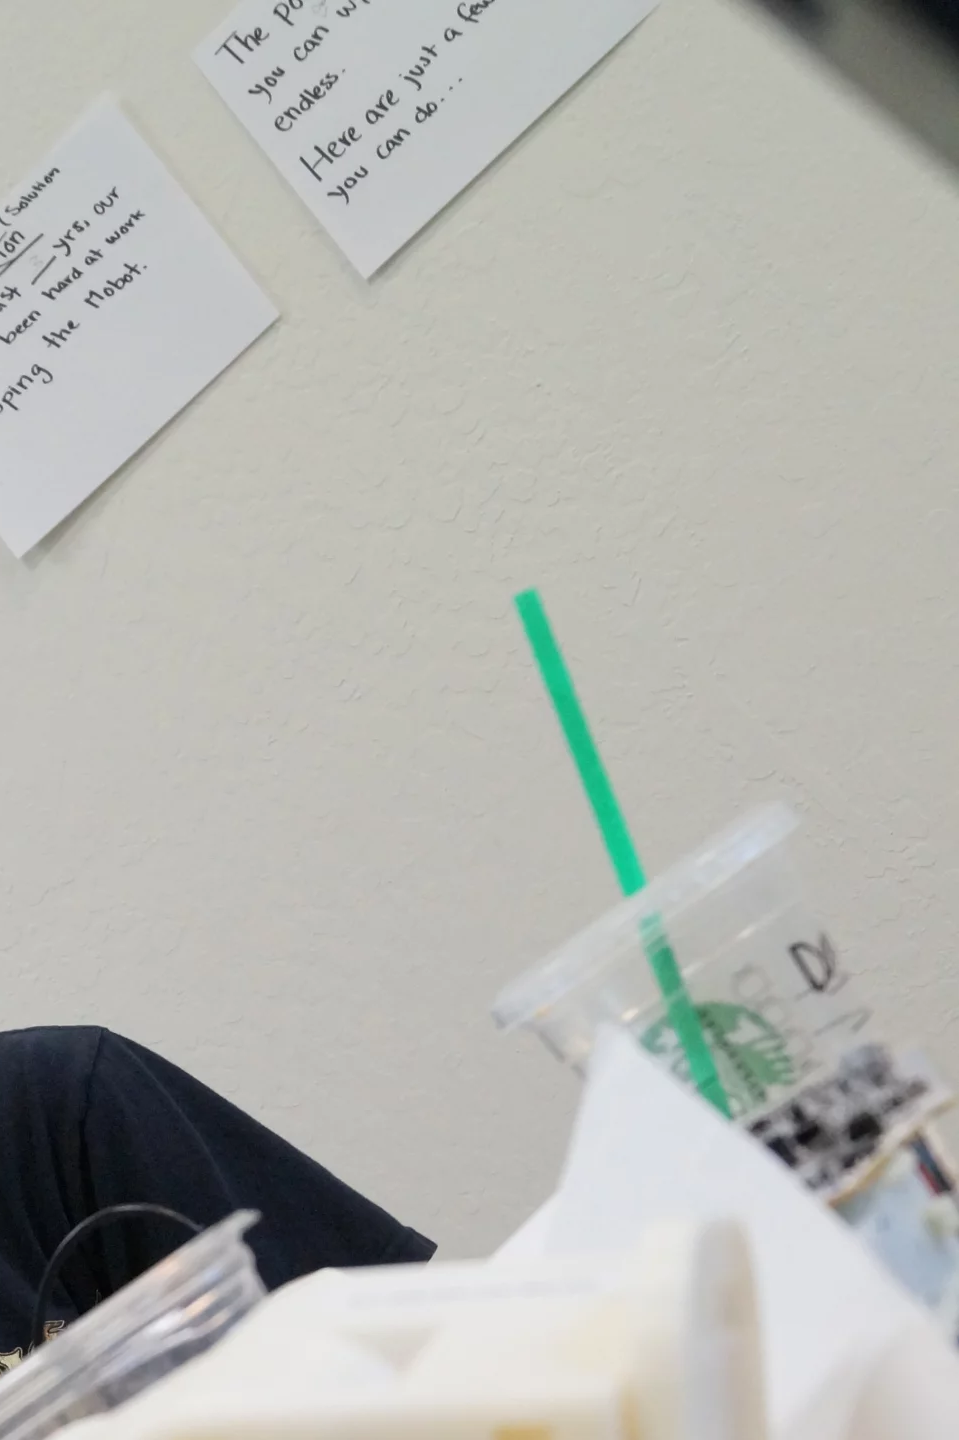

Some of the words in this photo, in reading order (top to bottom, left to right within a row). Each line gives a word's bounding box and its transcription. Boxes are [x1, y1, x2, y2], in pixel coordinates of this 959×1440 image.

[214, 26, 270, 64] The
[248, 65, 286, 104] you
[293, 25, 330, 62] can
[274, 68, 347, 132] endless.
[299, 125, 363, 182] Here
[365, 88, 400, 125] are
[399, 44, 438, 91] just
[444, 27, 463, 42] a
[93, 184, 122, 217] our
[327, 164, 369, 205] you
[376, 127, 411, 160] can
[41, 266, 84, 302] hard
[84, 247, 105, 267] at
[105, 208, 146, 247] work
[42, 318, 81, 352] the
